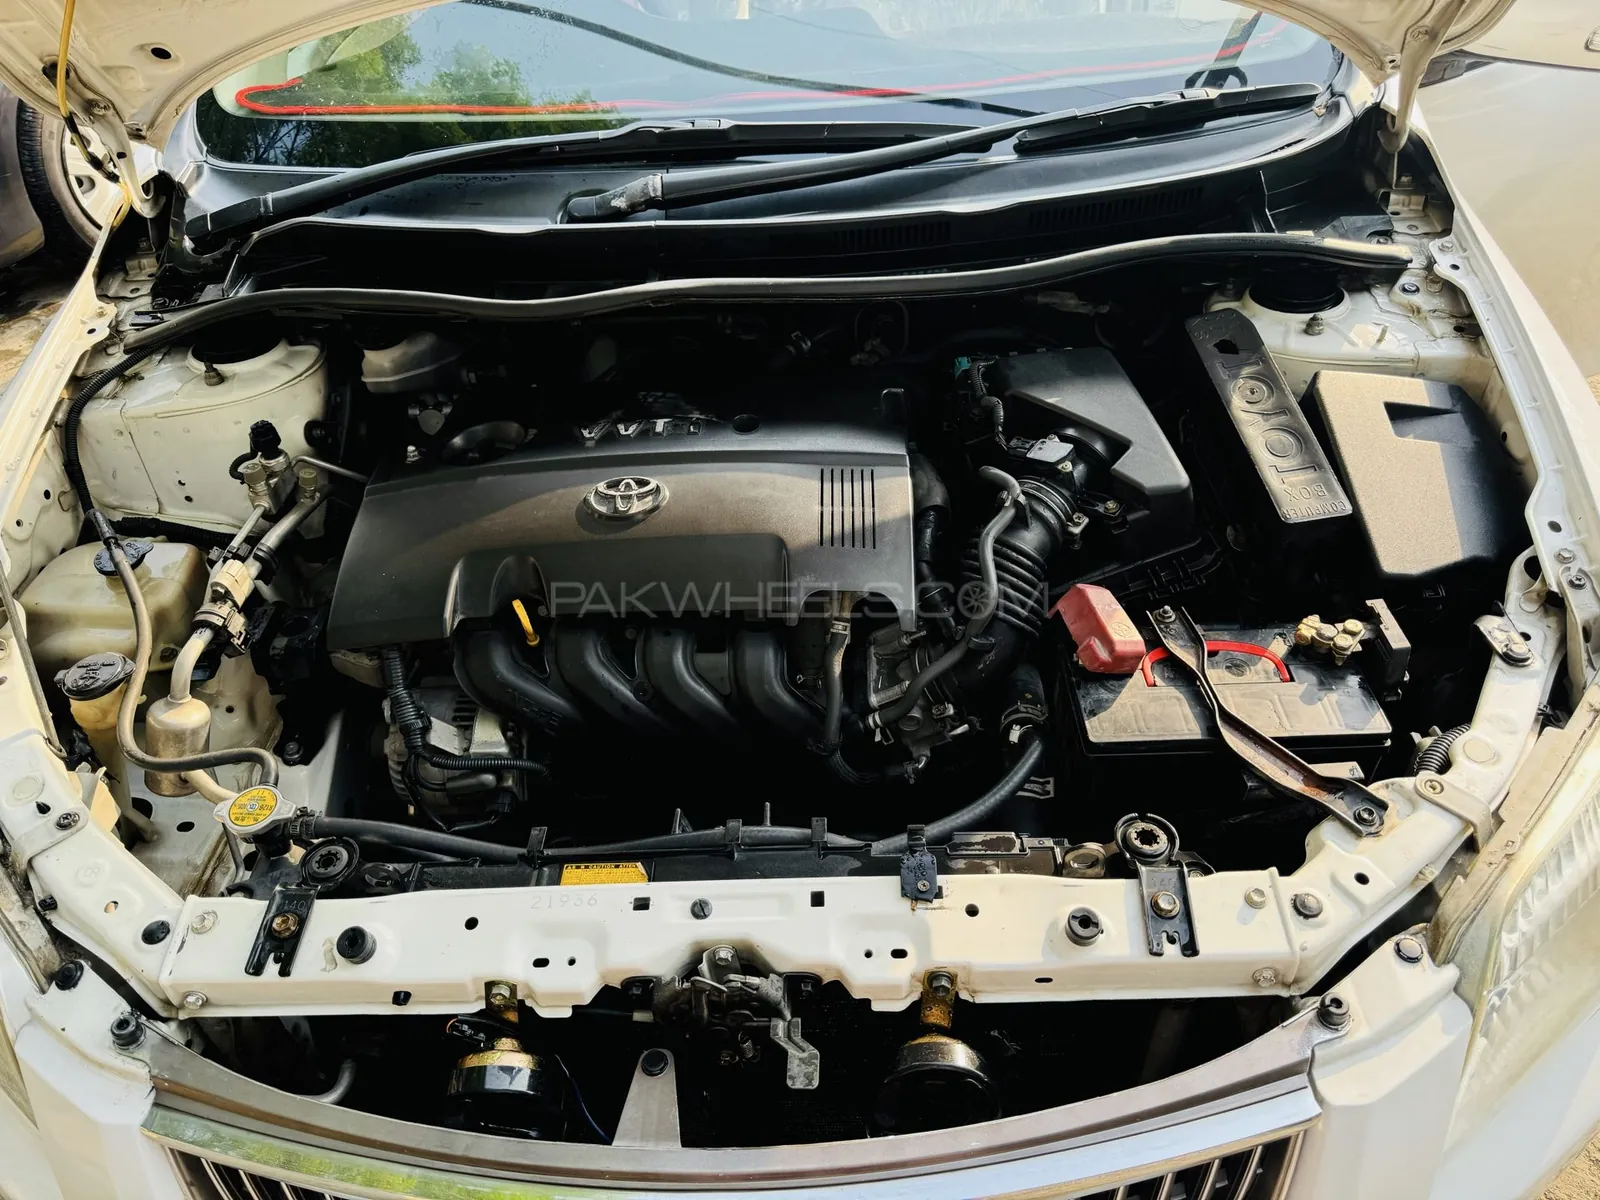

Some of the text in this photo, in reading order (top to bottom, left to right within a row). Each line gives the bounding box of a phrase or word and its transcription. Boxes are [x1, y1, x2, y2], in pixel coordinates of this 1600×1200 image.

[1208, 344, 1322, 490] TOYOT
[1283, 483, 1328, 502] BOX
[1280, 499, 1348, 521] COMPUTER
